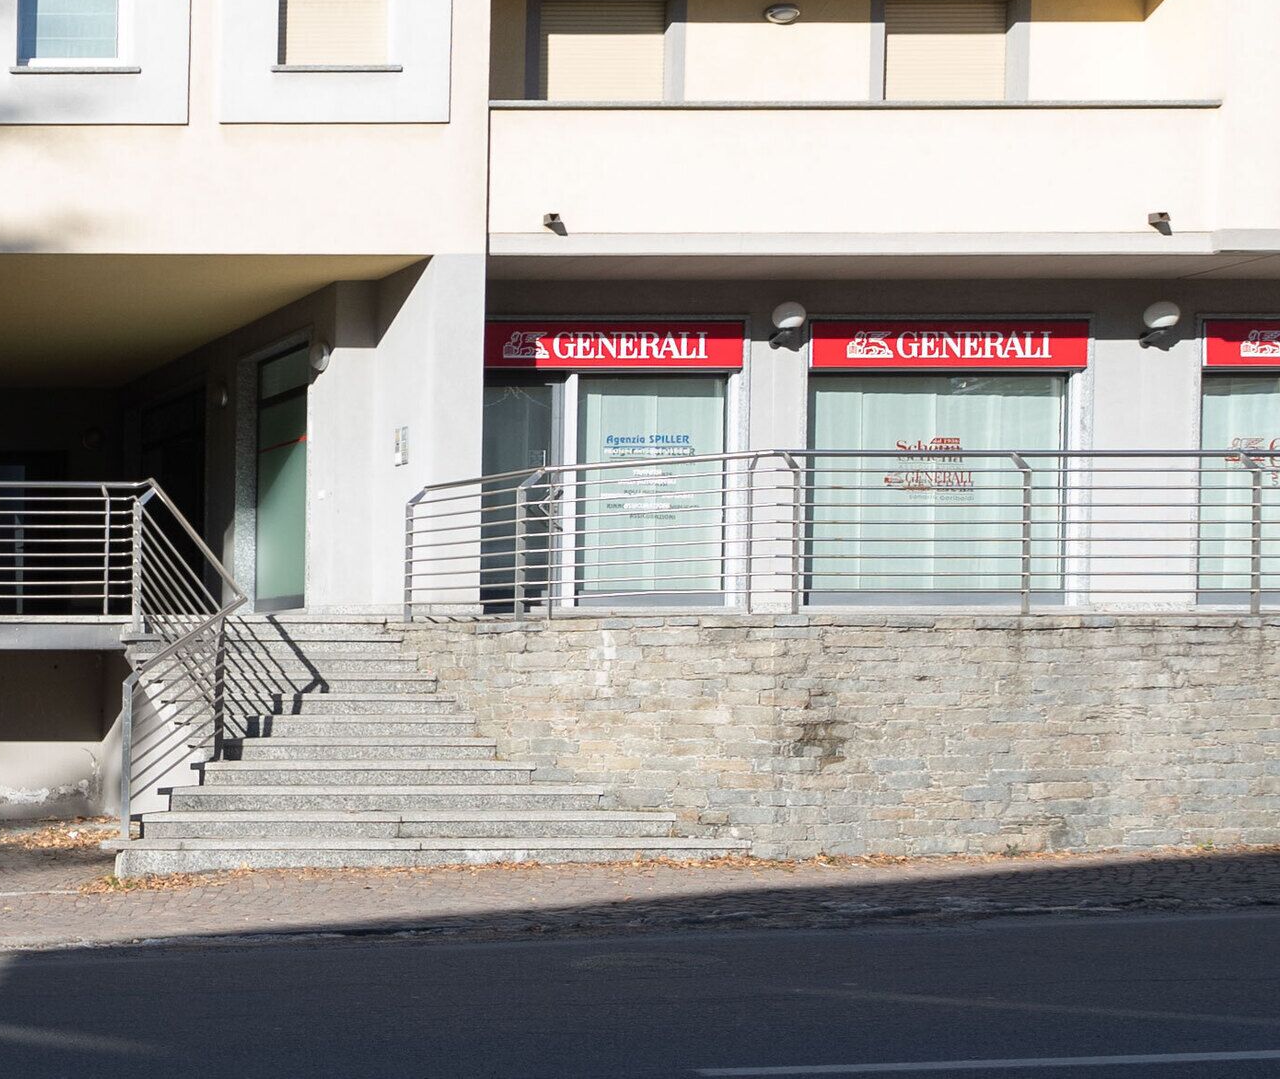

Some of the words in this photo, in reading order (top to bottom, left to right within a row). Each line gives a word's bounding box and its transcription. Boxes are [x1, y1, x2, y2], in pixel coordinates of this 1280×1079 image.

[552, 331, 708, 359] GENERALI
[895, 331, 1053, 359] GENERALI
[649, 434, 689, 444] SPILLER
